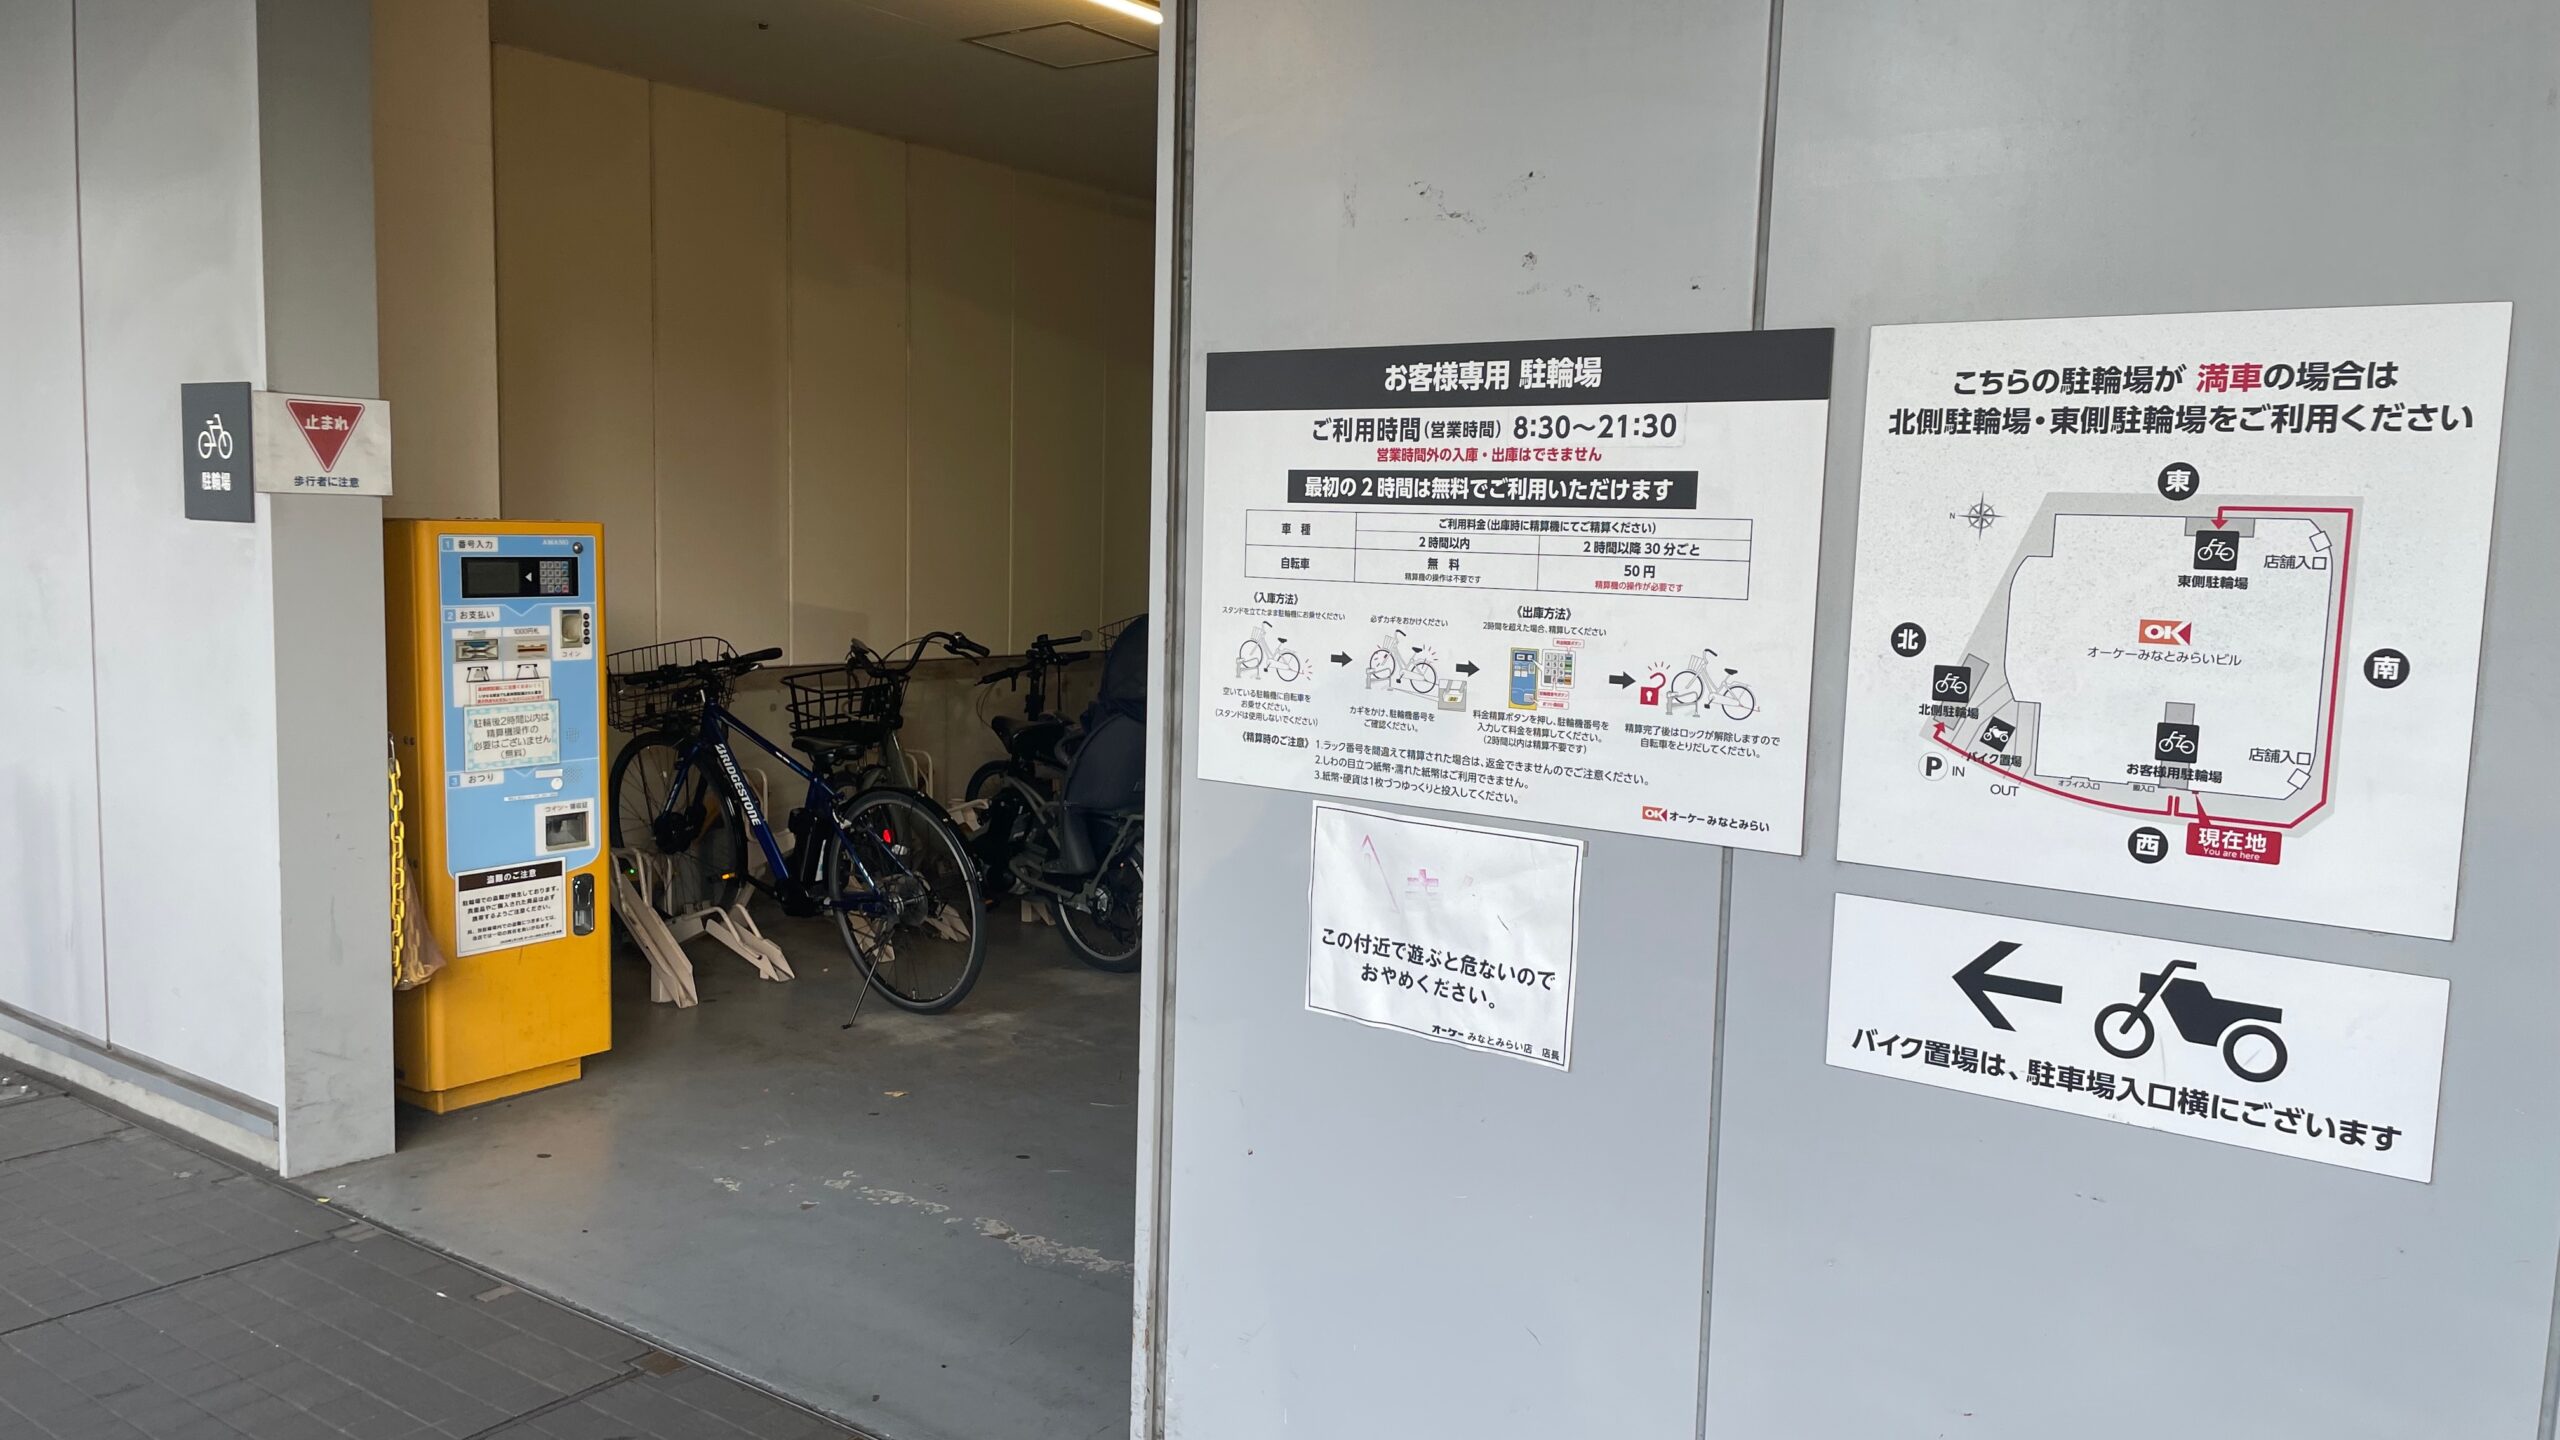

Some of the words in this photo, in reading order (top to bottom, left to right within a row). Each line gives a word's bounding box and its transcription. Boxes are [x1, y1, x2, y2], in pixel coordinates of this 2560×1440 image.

[1384, 359, 1510, 392] お客様専用
[1518, 356, 1602, 389] 駐輪場
[1953, 362, 2187, 396] こちらの駐輪場が
[2195, 360, 2400, 393] 満車の場合は
[304, 414, 350, 431] 止まれ
[1888, 401, 2473, 436] 北側駐輪場・東側駐輪場をご利用ください
[1376, 446, 1602, 463] 営業時間外の入庫・出庫はできません
[201, 471, 231, 492] 駐輪場
[293, 475, 360, 489] 歩行者に注意
[2165, 469, 2192, 493] 東
[1949, 511, 1956, 520] N
[1438, 518, 1657, 535] ご利用料金(出庫時に精算機にてご精算ください)
[444, 540, 450, 549] 1
[457, 539, 494, 550] 番号入力
[1280, 556, 1310, 570] 自転車
[2263, 554, 2328, 571] 店舗入口
[1404, 572, 1482, 584] 精算機の操作は不要です
[1594, 580, 1684, 593] 精算機の操作が必要です
[2177, 573, 2249, 590] 東側駐輪場
[459, 610, 495, 620] お支払い
[1369, 615, 1449, 628] 必ずカギをおかけください
[1482, 621, 1607, 637] 2時間を超えた場合、精算してください
[2143, 621, 2192, 646] OK
[1897, 627, 1920, 651] 北
[2087, 646, 2242, 666] オーケーみなとみらいビル
[2372, 655, 2401, 681] 南
[1222, 686, 1311, 703] 空いている駐輪機に自転車を
[1240, 700, 1291, 713] お乗せください。
[1349, 705, 1435, 722] カギをかけ、駐輪機番号を
[1918, 703, 1980, 720] 北側駐輪場
[1363, 719, 1419, 733] ご確認ください。
[1472, 709, 1609, 731] 料金精算ボタンを押し、駐輪機番号を
[486, 725, 539, 738] 精算機操作の
[1477, 722, 1603, 743] 入力して料金を精算してください。
[1624, 723, 1781, 746] 精算完了後はロックが解除しますので
[473, 735, 552, 751] 必要はございません
[1483, 736, 1588, 754] (2時間以内は精算不要です)
[1640, 737, 1761, 759] 自転車をとりだしてください。
[1966, 751, 2023, 768] バイク置場
[2248, 747, 2312, 766] 店舗入口
[1925, 756, 1943, 777] P
[1951, 765, 1966, 778] IN
[2126, 763, 2223, 784] お客様用駐輪場
[452, 778, 458, 786] 3
[468, 773, 495, 784] おつり
[714, 743, 762, 827] BRIDGESTONE
[1990, 783, 2020, 797] OUT
[1643, 806, 1667, 822] OK
[2136, 833, 2161, 857] 西
[2198, 827, 2267, 853] 現在地
[2203, 847, 2221, 857] You
[2223, 850, 2238, 858] are
[2239, 850, 2261, 861] here
[486, 868, 537, 885] 盗難のご注意
[1321, 927, 1556, 991] この付近で遊ぶと危ないので
[1360, 963, 1496, 1009] おやめください。
[1541, 1047, 1560, 1061] 店長
[1851, 1027, 2403, 1153] バイク置場は、駐車場入口横にございます
